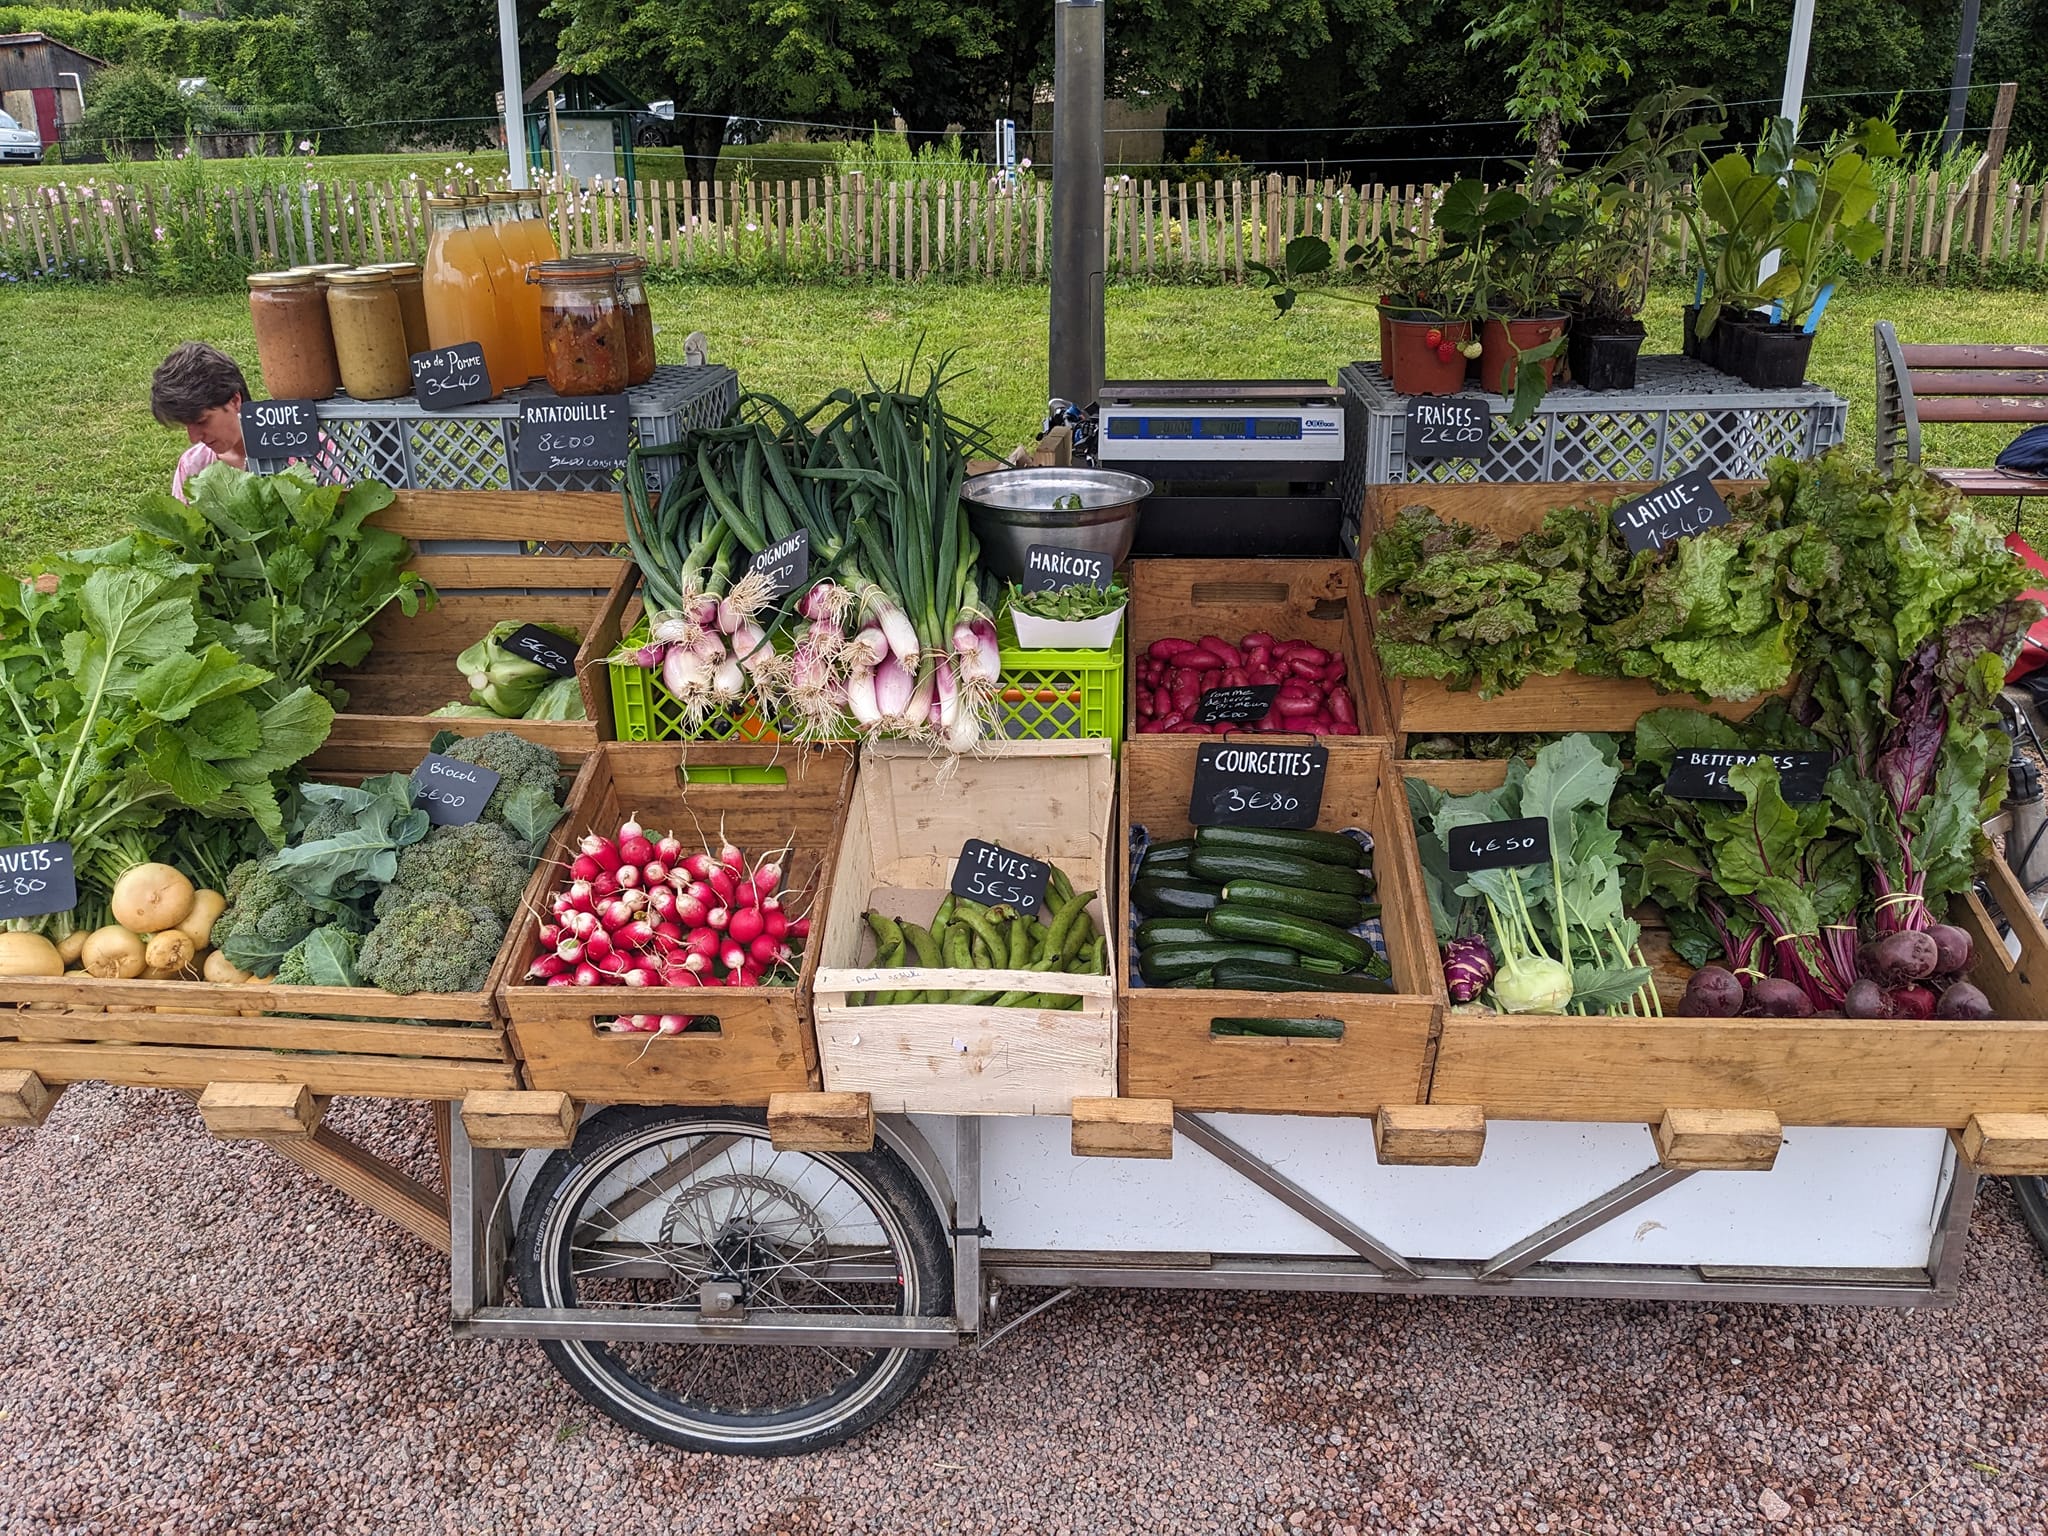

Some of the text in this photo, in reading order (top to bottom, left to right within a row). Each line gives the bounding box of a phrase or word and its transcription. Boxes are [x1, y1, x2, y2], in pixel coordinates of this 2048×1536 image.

[413, 359, 432, 378] Jus
[433, 354, 445, 367] de
[260, 431, 309, 447] 4€90
[537, 432, 595, 452] 8€00
[1419, 427, 1484, 444] 2€00
[1646, 506, 1714, 549] 1€40
[1029, 551, 1103, 580] HARICOTS
[519, 637, 568, 665] 5€00
[417, 784, 465, 807] 6€00
[1228, 787, 1299, 812] 3€80
[1468, 836, 1535, 857] 4€50
[966, 871, 1036, 908] 5€50
[532, 1198, 556, 1263] SCHWALBE
